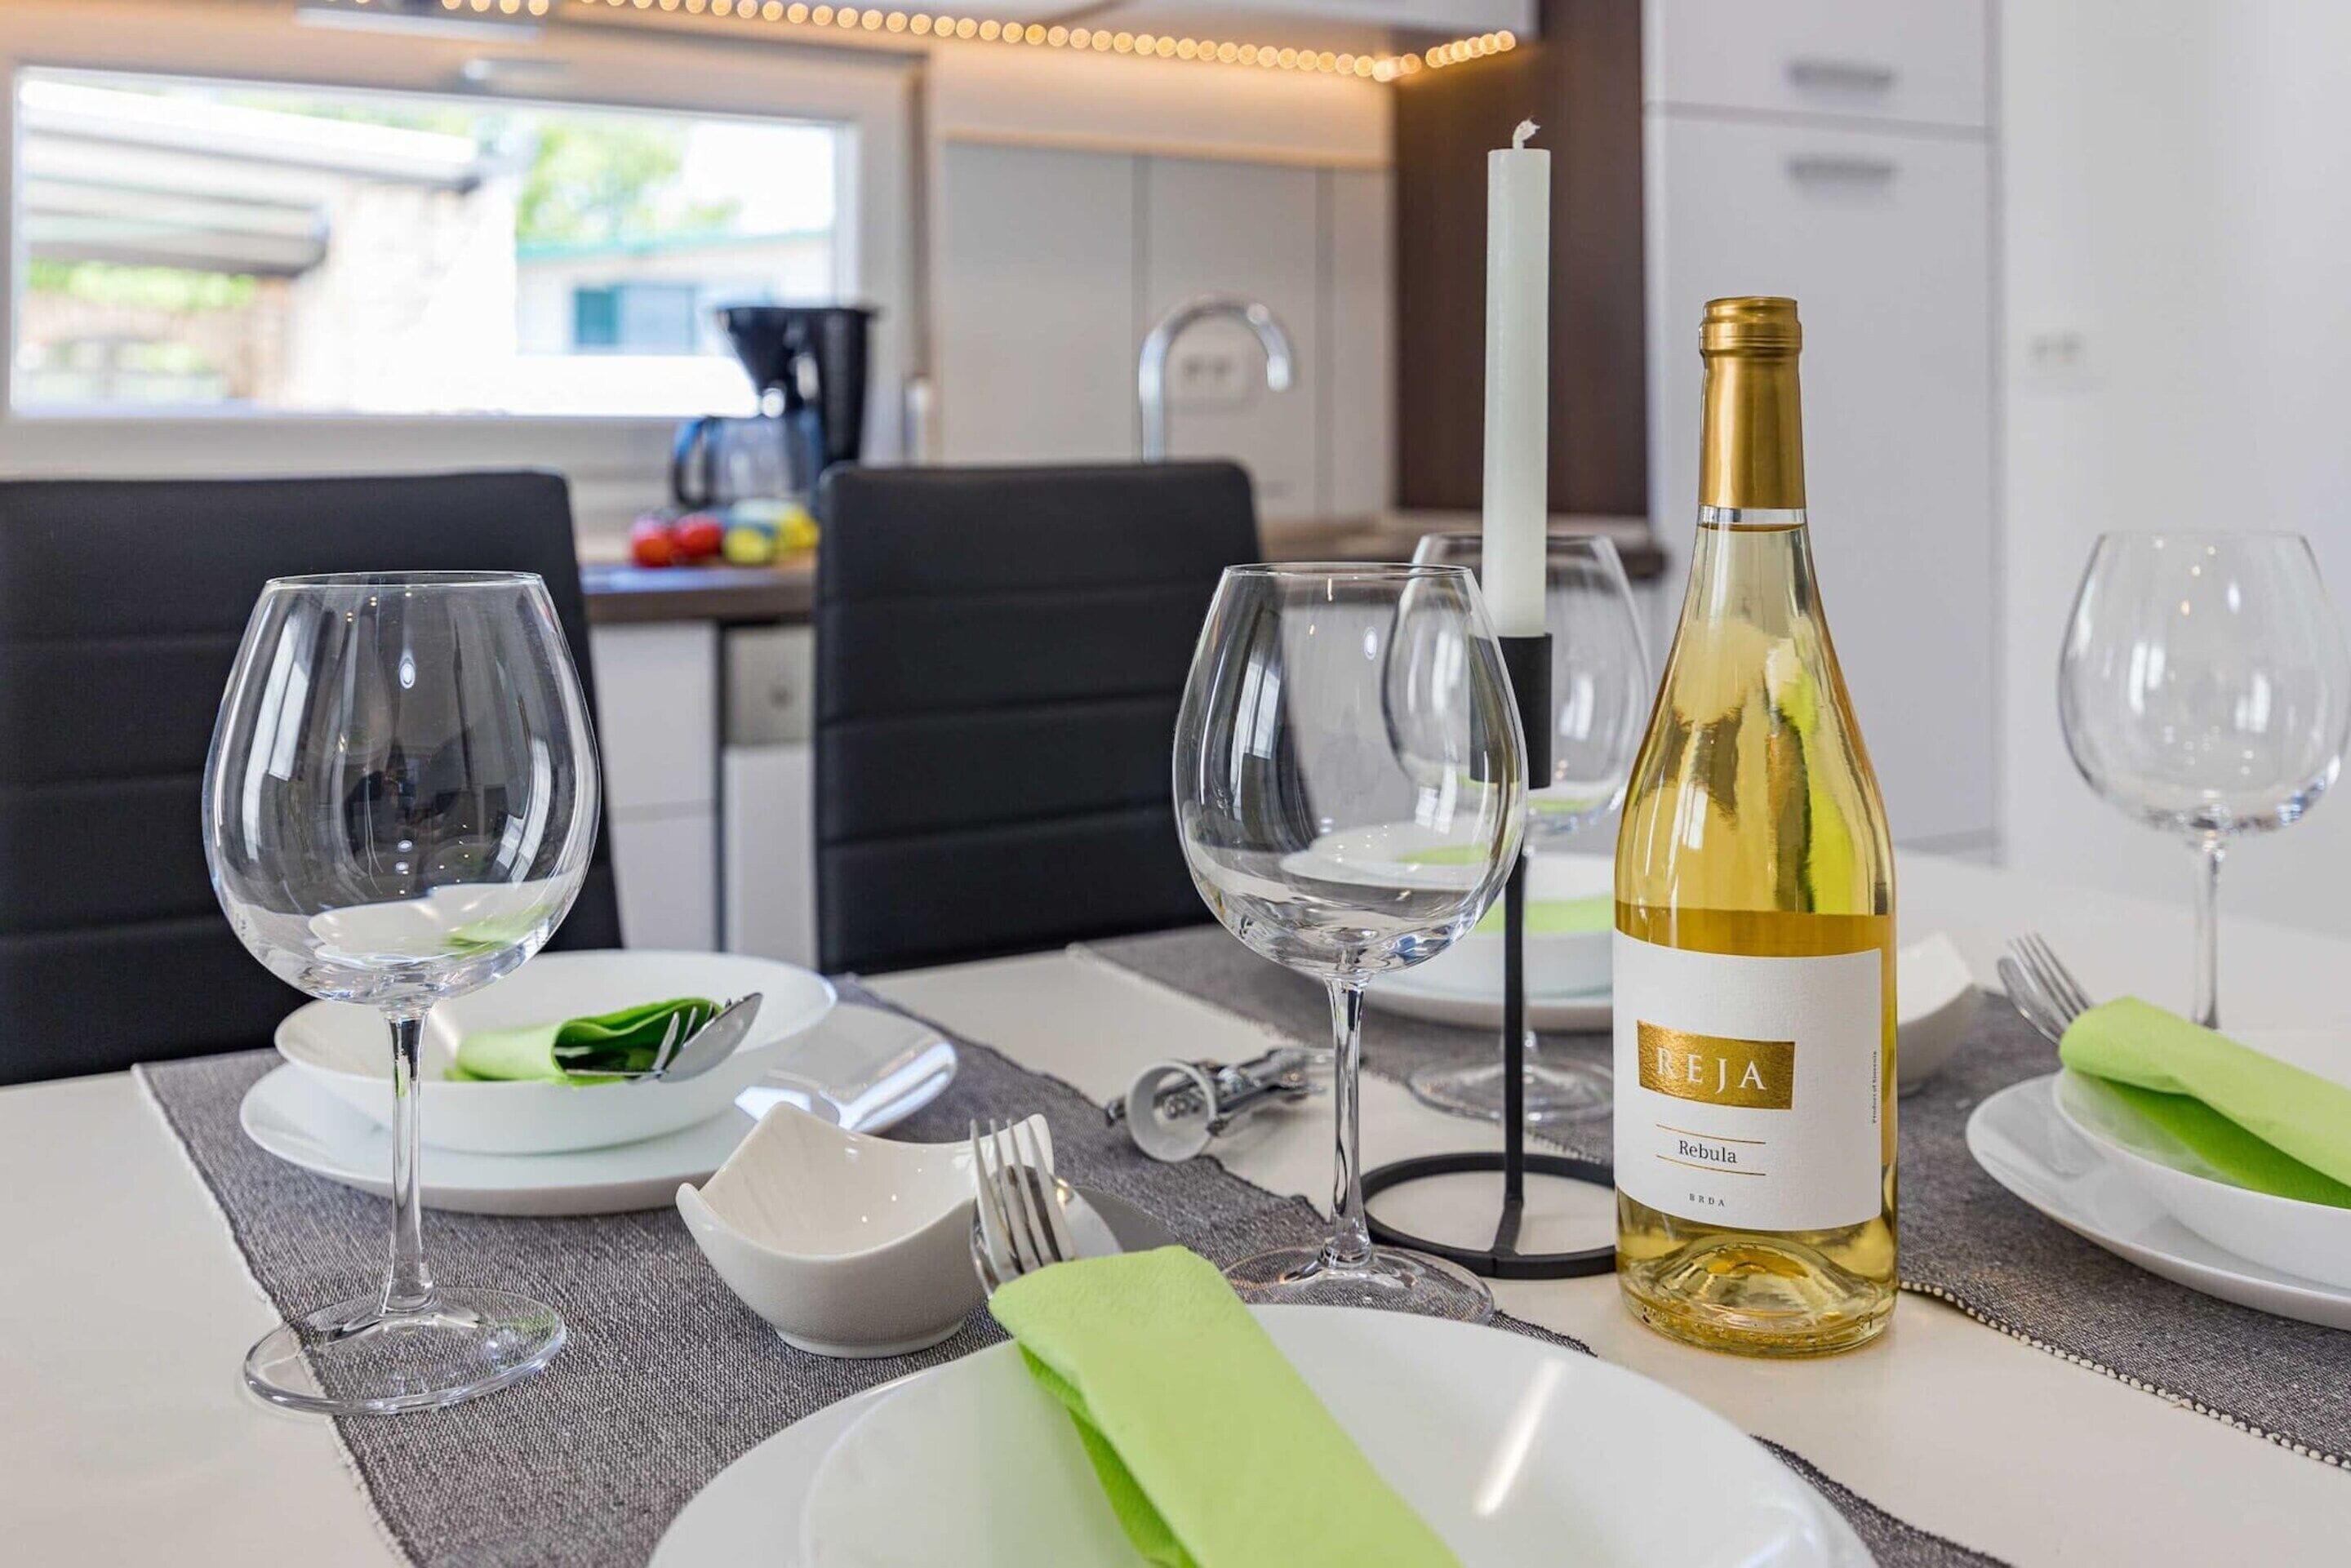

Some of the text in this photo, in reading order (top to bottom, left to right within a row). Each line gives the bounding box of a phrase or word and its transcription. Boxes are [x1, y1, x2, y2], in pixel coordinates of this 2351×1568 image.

[1656, 1046, 1767, 1094] REJA
[1678, 1140, 1737, 1164] Rebula
[1689, 1193, 1726, 1207] BRDA
